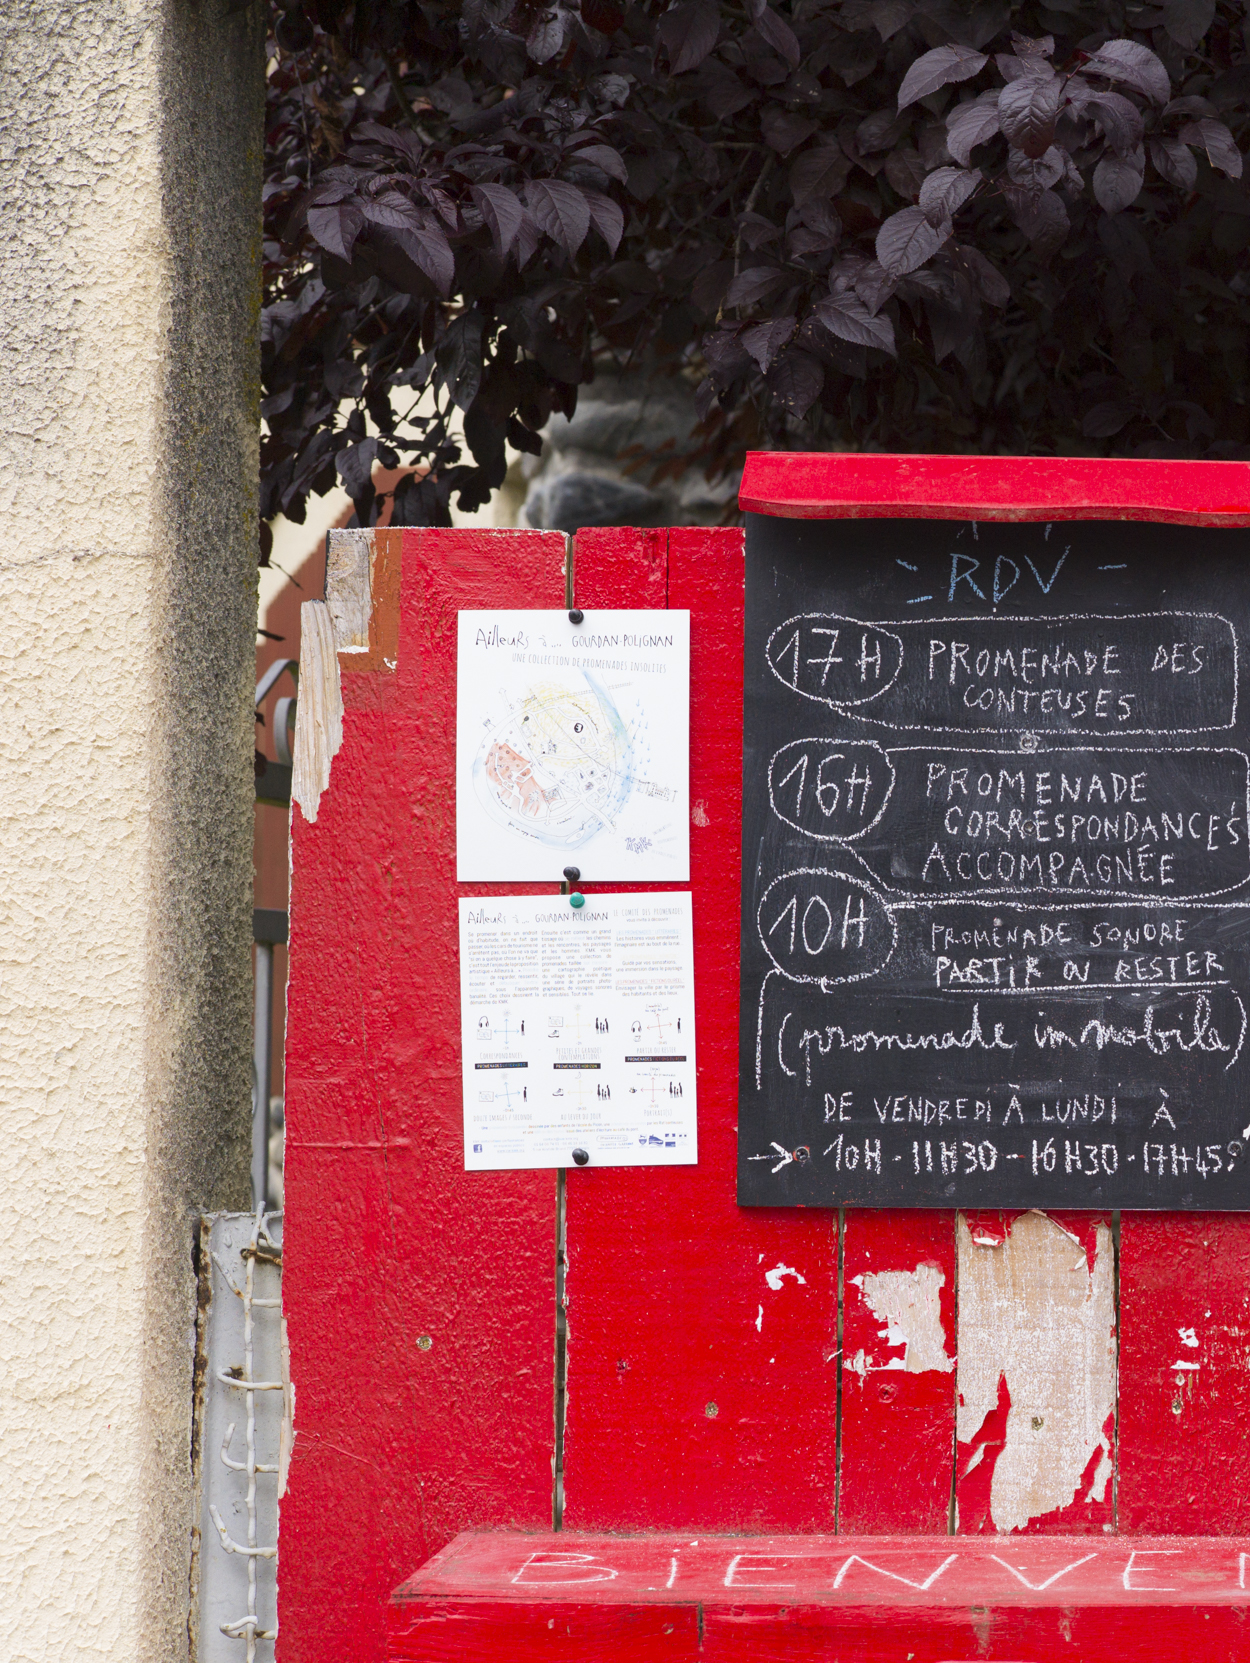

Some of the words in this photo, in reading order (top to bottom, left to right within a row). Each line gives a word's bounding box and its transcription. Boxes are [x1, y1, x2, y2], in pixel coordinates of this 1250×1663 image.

[948, 546, 1071, 602] RDV
[512, 652, 526, 663] UNE
[528, 654, 570, 667] COLLECTION
[572, 657, 580, 667] DE
[582, 658, 627, 671] PROMENADES
[630, 661, 667, 674] INSOLITES
[928, 639, 1122, 684] PROMENADE
[1151, 644, 1204, 674] DES
[963, 683, 1136, 721] CONTEUSES
[778, 754, 872, 817] 16H
[927, 763, 1147, 803] PROMENADE
[945, 806, 1242, 852] CORRESPONDANCES
[922, 843, 1176, 887] ACCOMPAGNÉE
[768, 895, 870, 956] 10H
[932, 920, 1071, 952] PROMENADE
[1092, 919, 1187, 950] SONORE
[1114, 950, 1225, 983] RESTER
[823, 1092, 853, 1123] DE
[873, 1096, 992, 1125] VENDREDI
[1002, 1084, 1025, 1126] À
[1041, 1096, 1117, 1125] LUNDI
[1152, 1088, 1176, 1130] À
[823, 1133, 882, 1175] 10H
[913, 1140, 997, 1175] 11H30
[1031, 1137, 1119, 1175] 16H30
